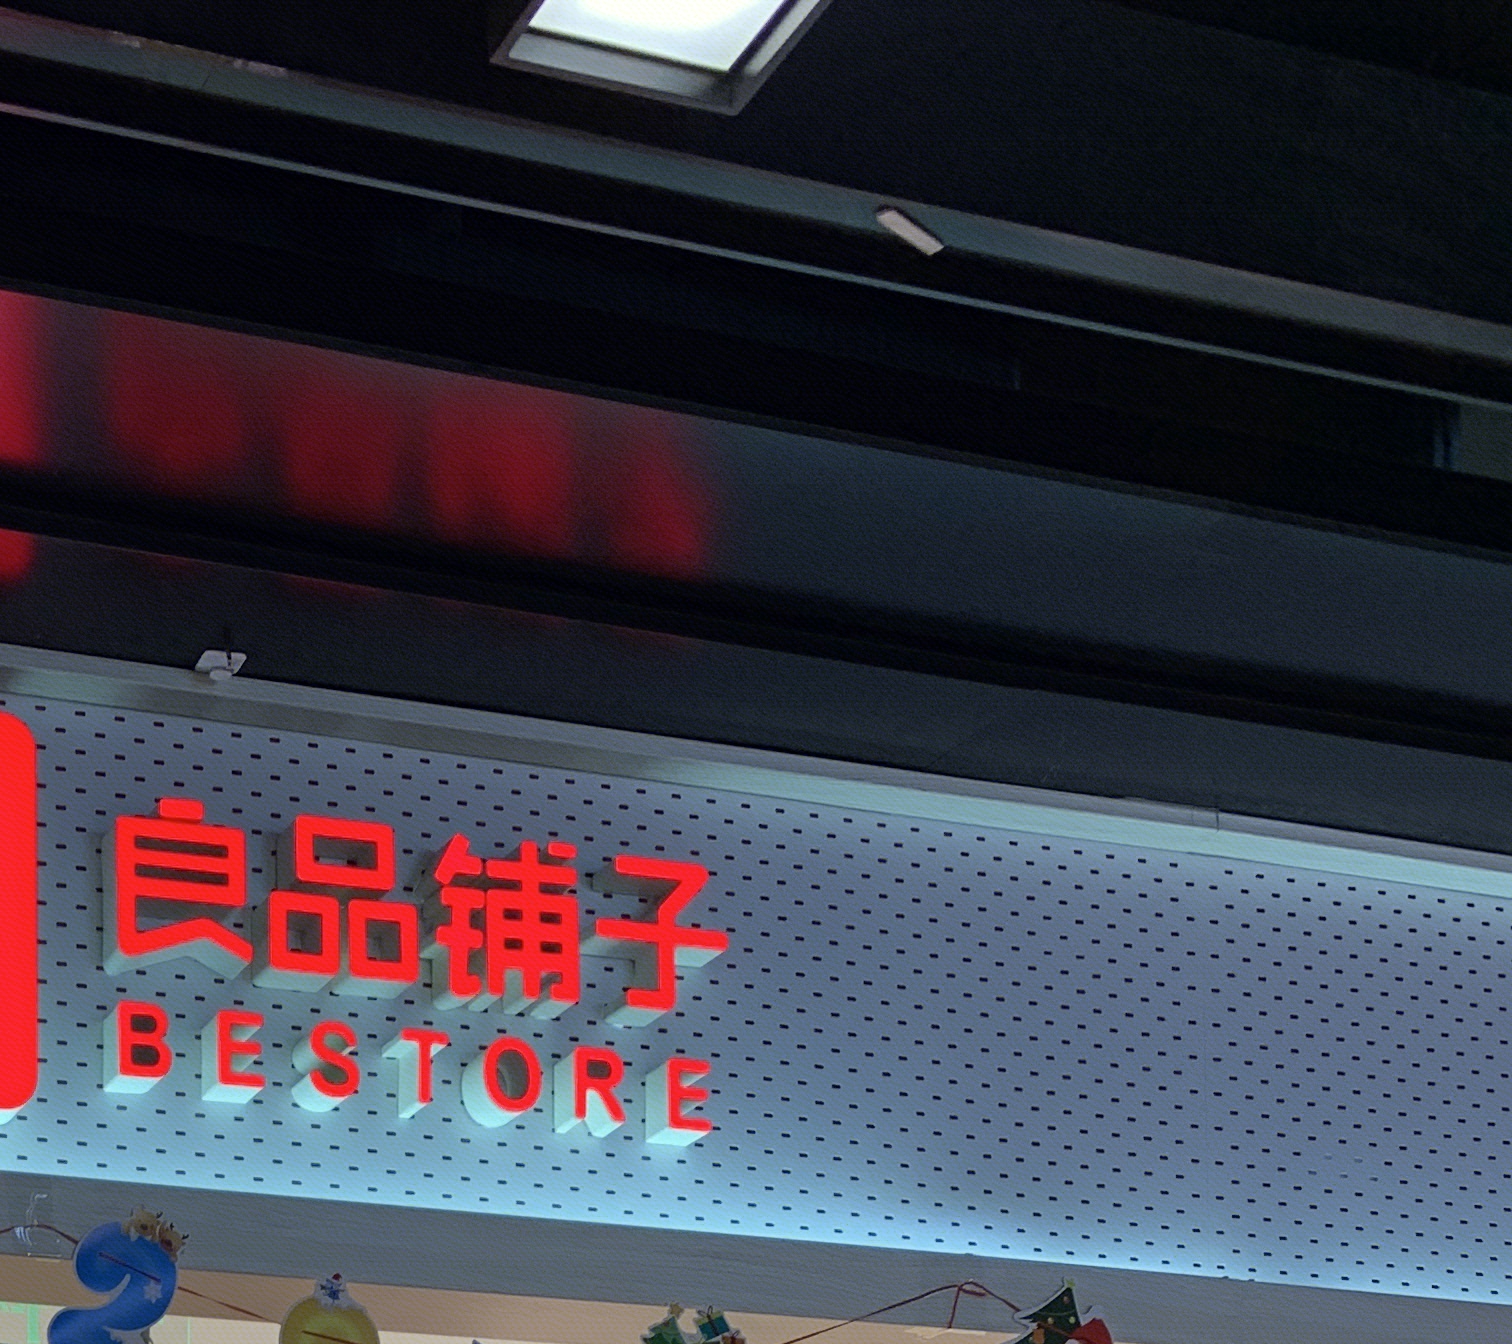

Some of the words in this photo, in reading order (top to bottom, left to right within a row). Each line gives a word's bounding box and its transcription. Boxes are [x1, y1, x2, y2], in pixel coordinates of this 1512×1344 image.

[115, 798, 728, 1012] 良品铺子
[117, 1002, 710, 1132] BESTORE
